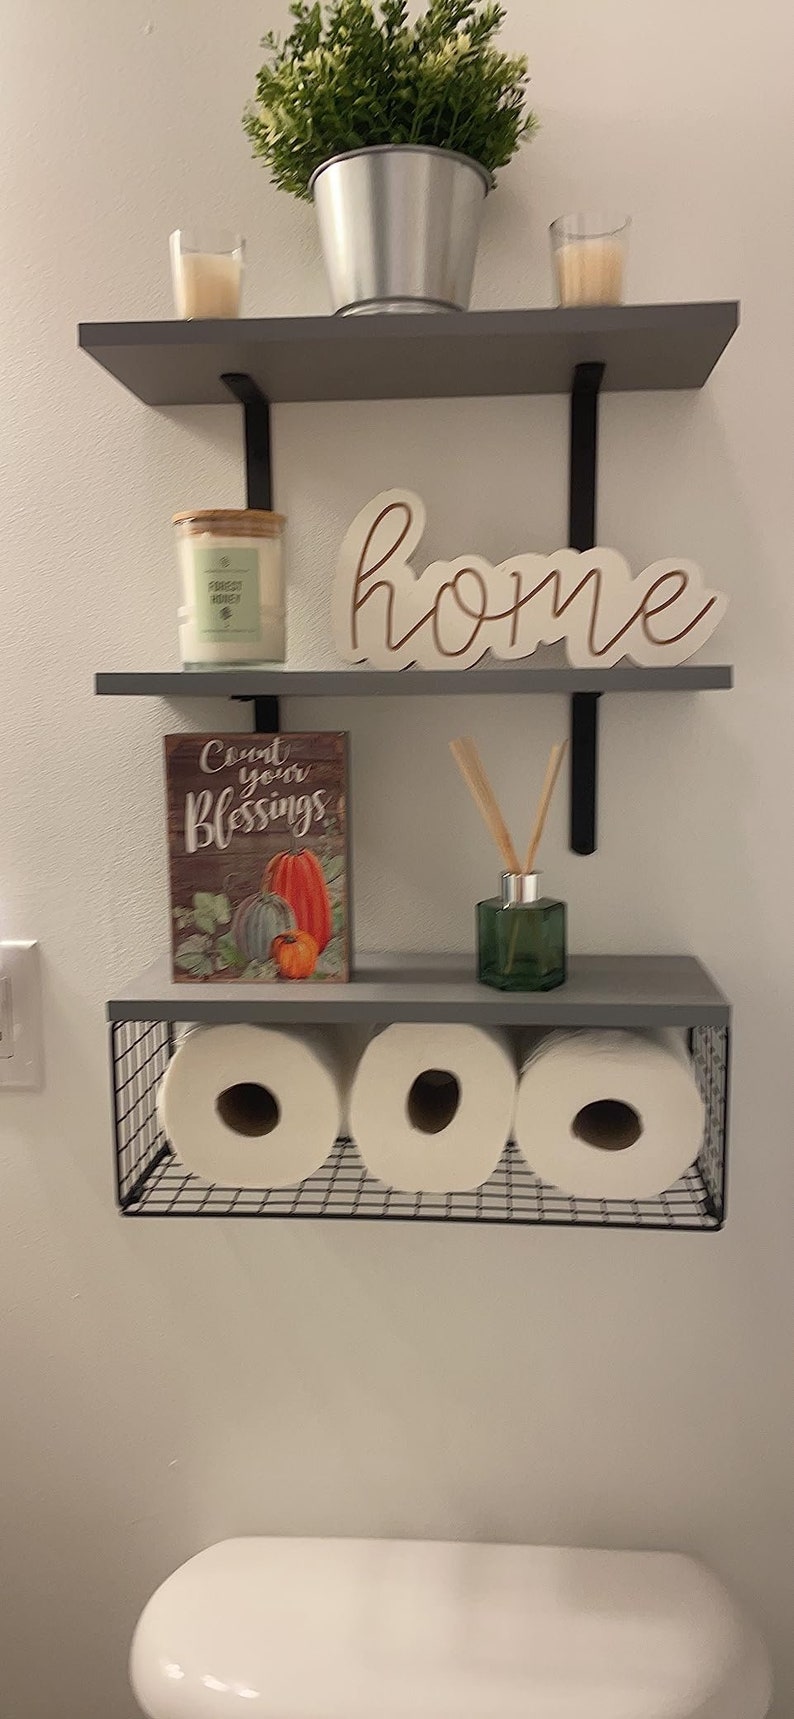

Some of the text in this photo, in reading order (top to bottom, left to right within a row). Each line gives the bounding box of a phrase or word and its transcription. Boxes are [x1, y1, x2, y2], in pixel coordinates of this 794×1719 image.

[350, 501, 718, 658] home
[199, 736, 291, 775] Count
[238, 762, 313, 800] your
[184, 785, 334, 854] Blessings
